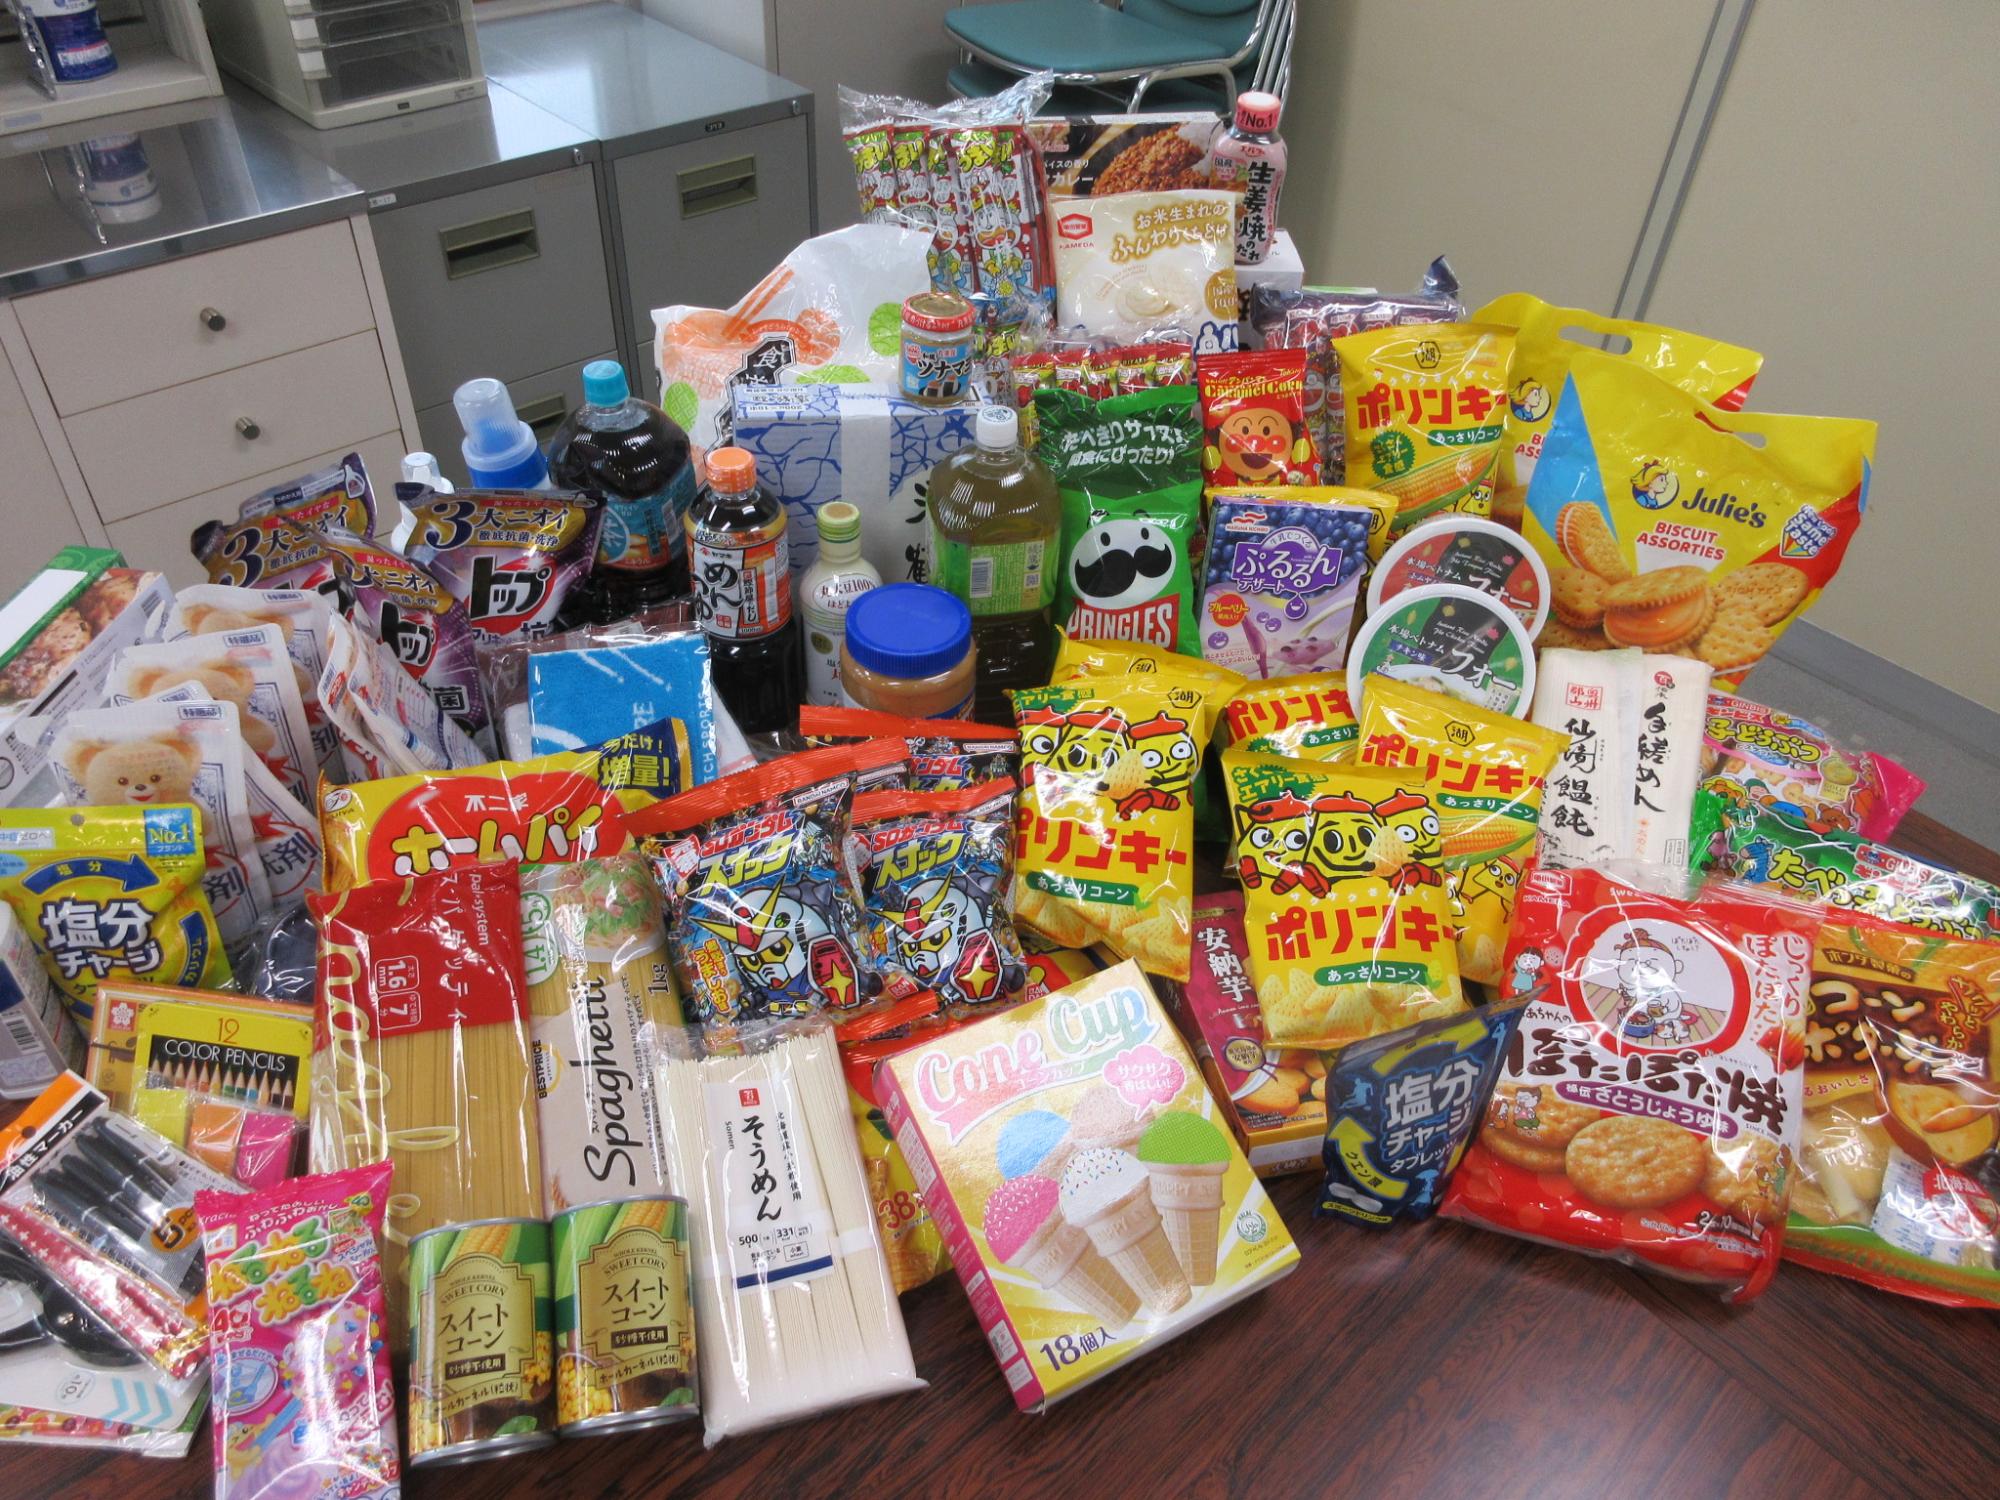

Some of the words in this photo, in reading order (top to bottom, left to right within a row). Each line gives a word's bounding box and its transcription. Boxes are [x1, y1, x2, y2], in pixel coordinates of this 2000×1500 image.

[1245, 112, 1274, 128] No.1
[1356, 382, 1508, 430] ポリンキー
[425, 500, 570, 550] 3大ニオイ
[1682, 488, 1768, 529] Julie's
[1636, 532, 1726, 562] ASSORTIES
[1655, 521, 1719, 544] BISCUIT
[1235, 545, 1337, 589] ぷるるん
[468, 554, 552, 620] トップ
[1237, 577, 1286, 594] デザート
[1066, 602, 1173, 650] PRINGLES
[1440, 648, 1518, 691] フォー
[1730, 699, 1769, 715] GINBIS
[599, 754, 671, 787] 増量!
[1444, 795, 1535, 821] あっさりコーン
[149, 825, 192, 844] No.1
[392, 805, 603, 877] ホームパイ
[872, 834, 964, 893] スナック
[42, 899, 155, 951] 塩分
[1265, 904, 1463, 961] ポリンキー
[56, 939, 161, 981] チャージ
[377, 966, 387, 988] mm
[385, 959, 408, 990] 1.6
[1197, 927, 1252, 1002] 安納芋
[1326, 964, 1422, 983] あっさりコーン
[647, 962, 669, 996] 1kg
[217, 1016, 240, 1045] 12
[1938, 1000, 1966, 1051] やわらか
[164, 1039, 220, 1062] COLOR
[225, 1048, 286, 1072] PENCILS
[915, 1031, 1042, 1113] Cone
[1049, 986, 1148, 1056] Cup
[535, 1038, 549, 1100] BESTPRICE
[568, 974, 645, 1187] Spaghetti
[1501, 1025, 1789, 1137] ぽたぽた焼
[1385, 1059, 1480, 1129] 塩分
[6, 1108, 83, 1181] 油性マーカー
[724, 1120, 736, 1151] Somen
[1386, 1102, 1472, 1157] チャージ
[741, 1113, 783, 1223] そうめん
[155, 1219, 184, 1249] 5
[603, 1258, 637, 1277] SWEET
[638, 1256, 668, 1271] CORN
[474, 1281, 508, 1297] CORN
[603, 1275, 671, 1307] スイート
[439, 1303, 509, 1337] スイート
[610, 1301, 667, 1326] コーン
[446, 1329, 506, 1356] コーン
[614, 1328, 666, 1346] 砂糖不使用
[1040, 1326, 1118, 1372] 18個入
[448, 1356, 504, 1378] 砂糖不使用
